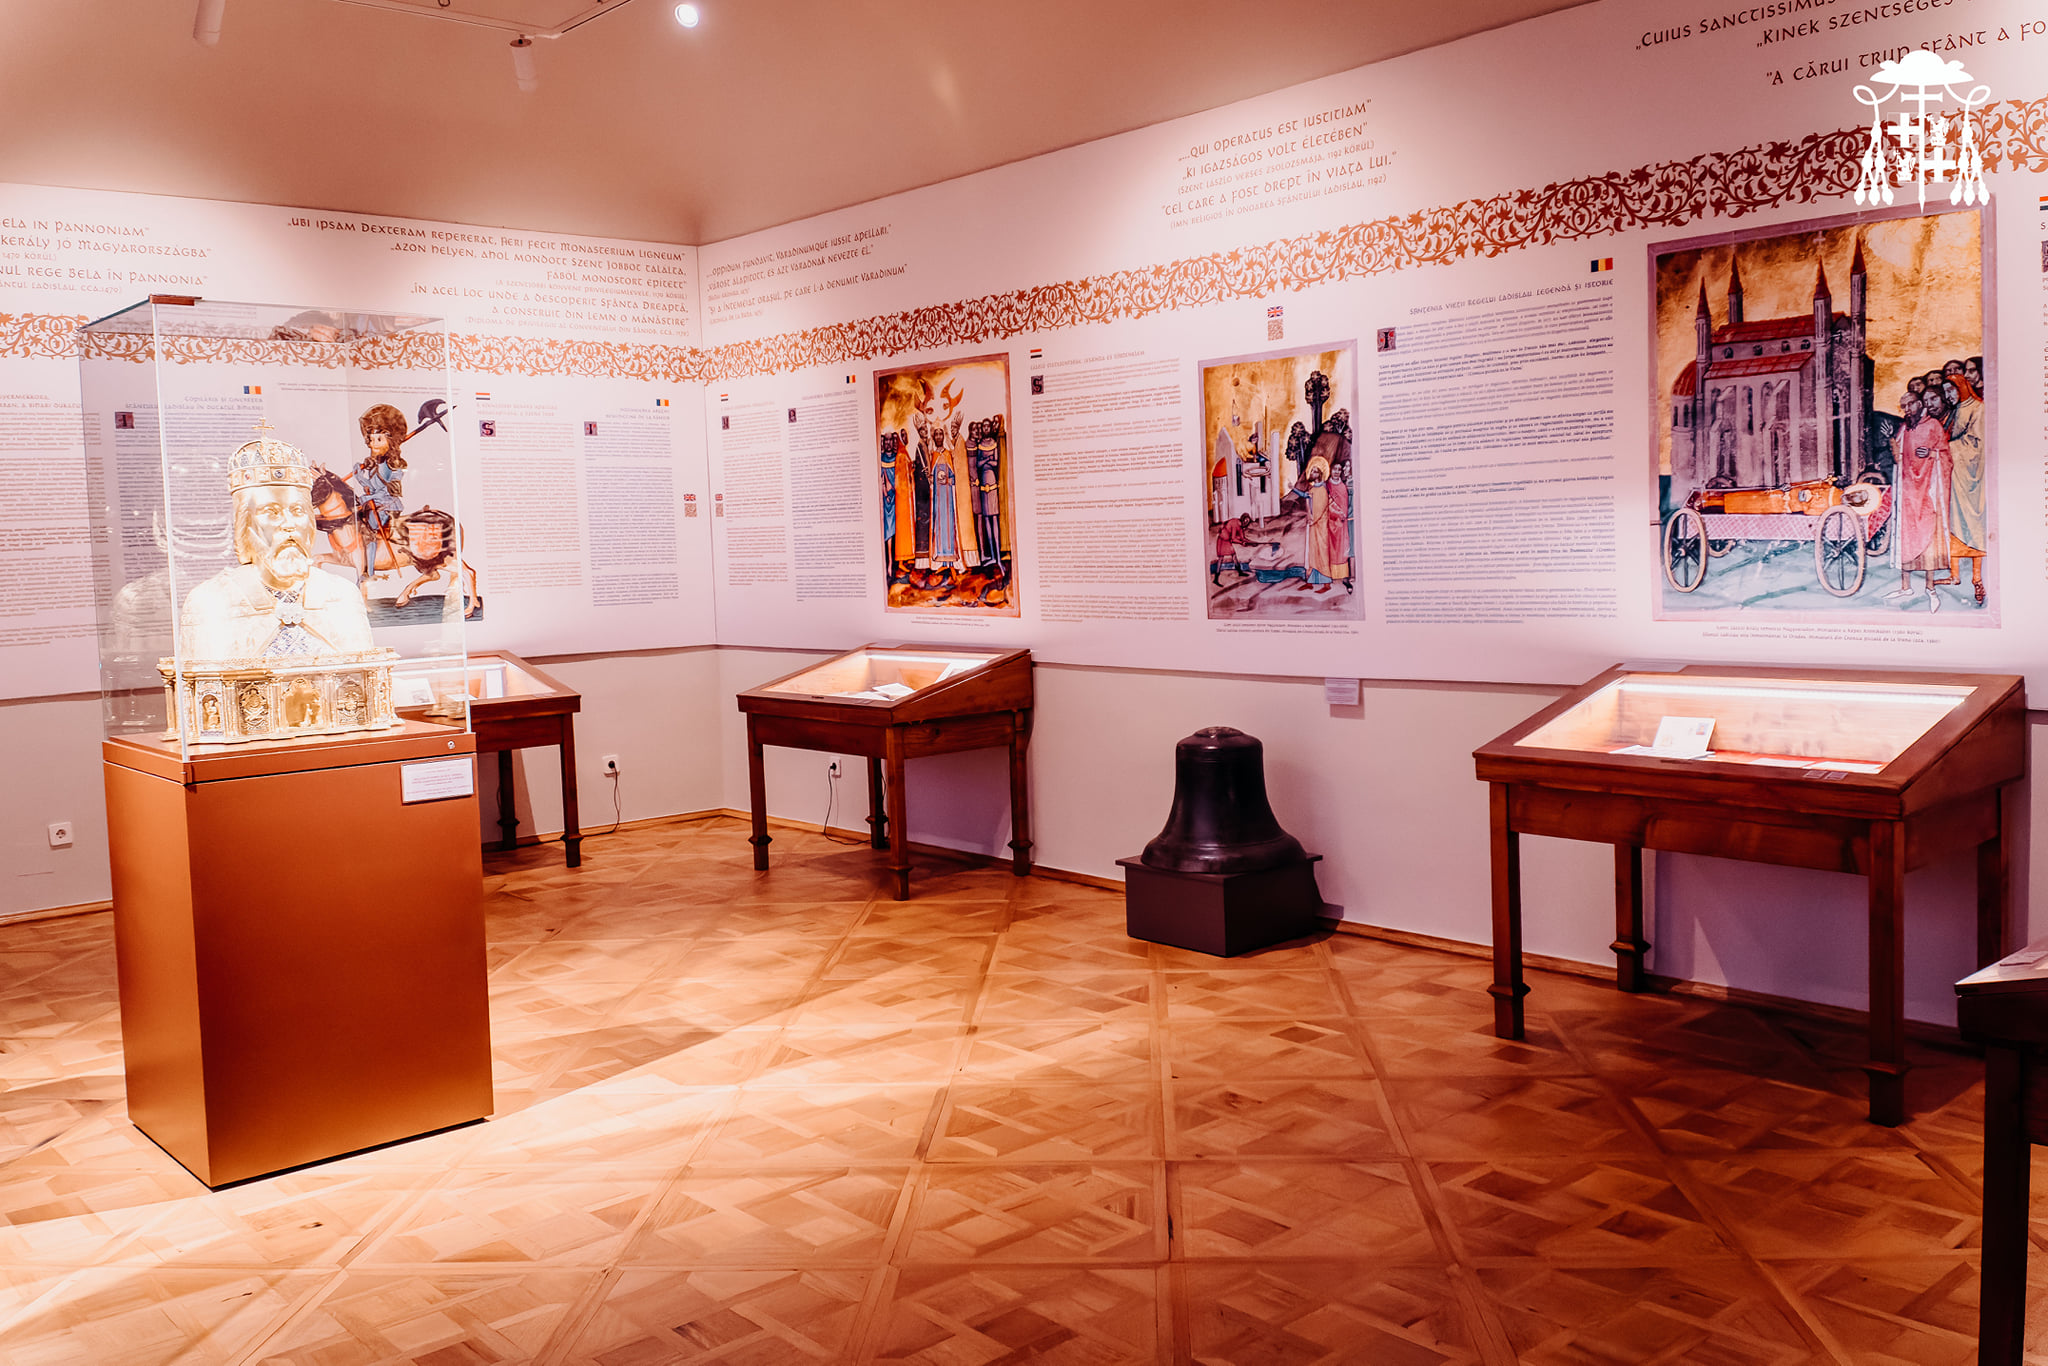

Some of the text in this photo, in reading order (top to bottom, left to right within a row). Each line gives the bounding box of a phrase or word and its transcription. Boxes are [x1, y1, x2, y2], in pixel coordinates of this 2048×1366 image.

[1636, 0, 1836, 50] „CUIUS SANCTISSIMU
[1757, 19, 1820, 47] „KINEK
[1793, 57, 1849, 81] CĂRUI
[1997, 27, 2010, 41] A
[2020, 20, 2047, 42] FO
[1214, 128, 1273, 152] OPERATUS
[1278, 120, 1299, 135] EST
[1303, 98, 1372, 128] IUSTITIAM"
[1200, 150, 1263, 175] IGAZSÁGOS
[1267, 141, 1297, 158] VOLT
[1187, 195, 1215, 211] CARE
[1219, 193, 1227, 204] A
[1231, 185, 1259, 204] FOST
[1264, 175, 1302, 194] DREPT
[0, 217, 27, 229] ELA
[33, 220, 48, 230] IN
[316, 219, 356, 232] IPSAM
[361, 222, 426, 239] DEXTERAM
[431, 231, 497, 246] REPERERAT,
[528, 240, 557, 250] FECIT
[560, 242, 636, 257] MONASTERIUM
[775, 240, 829, 260] VARADINUMQUE
[831, 233, 852, 247] IUSSIT
[513, 253, 568, 266] MONDOTT
[571, 258, 603, 269] SZENT
[607, 261, 641, 272] JOBBOT
[828, 248, 859, 263] NEVEZTE
[27, 266, 63, 277] REGE
[69, 268, 102, 280] BELA
[581, 273, 643, 287] MONOSTORT
[432, 286, 459, 297] ACEL
[463, 287, 484, 298] LOC
[488, 290, 519, 301] UNDE
[523, 293, 531, 301] A
[534, 292, 598, 307] DESCOPERIT
[795, 285, 811, 297] CARE
[826, 275, 859, 289] DENUMIT
[1499, 290, 1533, 302] LADISLAU
[1584, 279, 1614, 289] ISTORIE
[491, 306, 498, 314] A
[503, 306, 561, 319] CONSTRUIT
[565, 310, 584, 320] DIN
[587, 312, 618, 322] LEMN
[620, 314, 628, 322] O
